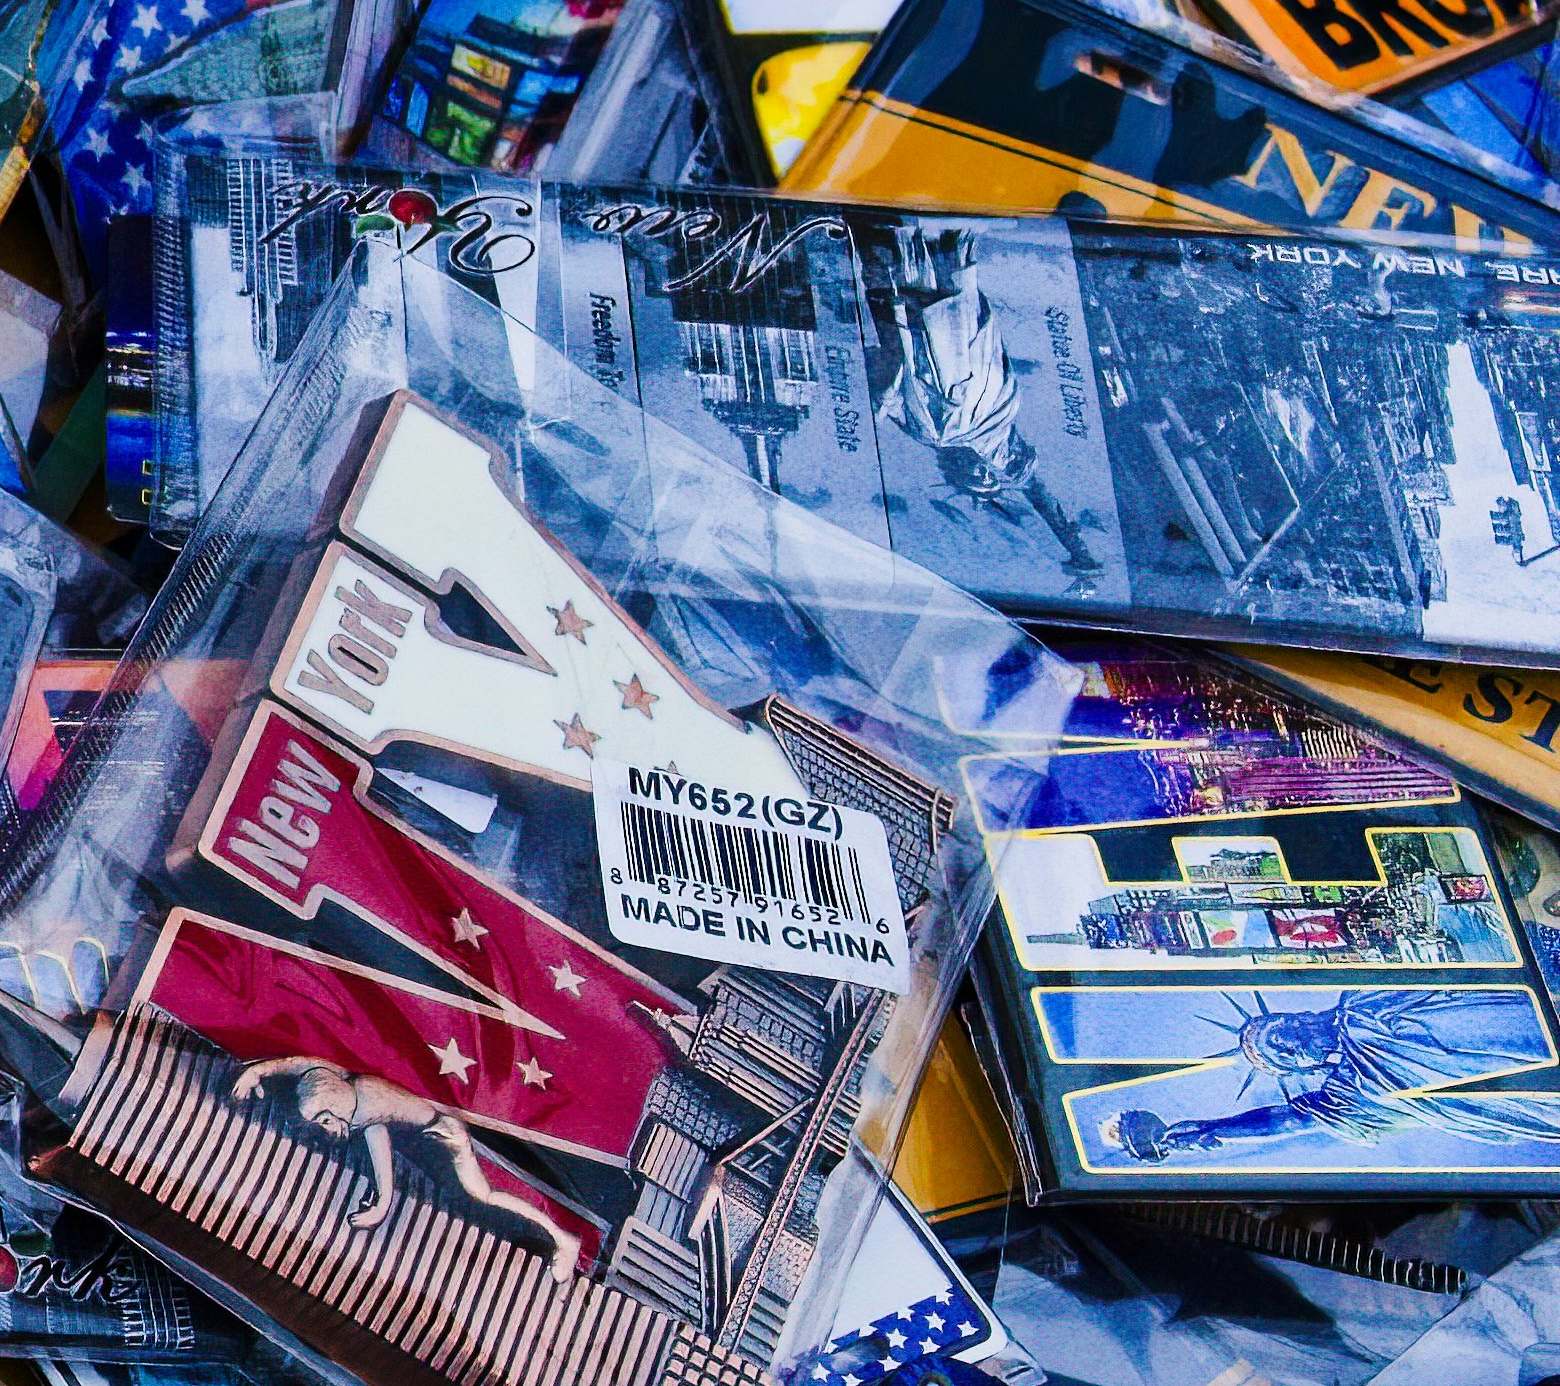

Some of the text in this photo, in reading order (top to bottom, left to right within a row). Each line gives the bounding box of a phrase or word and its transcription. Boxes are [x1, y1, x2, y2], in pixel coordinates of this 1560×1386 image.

[587, 201, 850, 296] New
[1247, 241, 1465, 279] NEW YORK
[823, 343, 861, 455] Empire State
[1065, 379, 1096, 442] Liberty
[229, 579, 412, 889] New York
[626, 767, 845, 841] MY652(GZ)
[610, 867, 890, 934] 8 87257 91652 6
[620, 894, 895, 969] MADE IN CHINA
